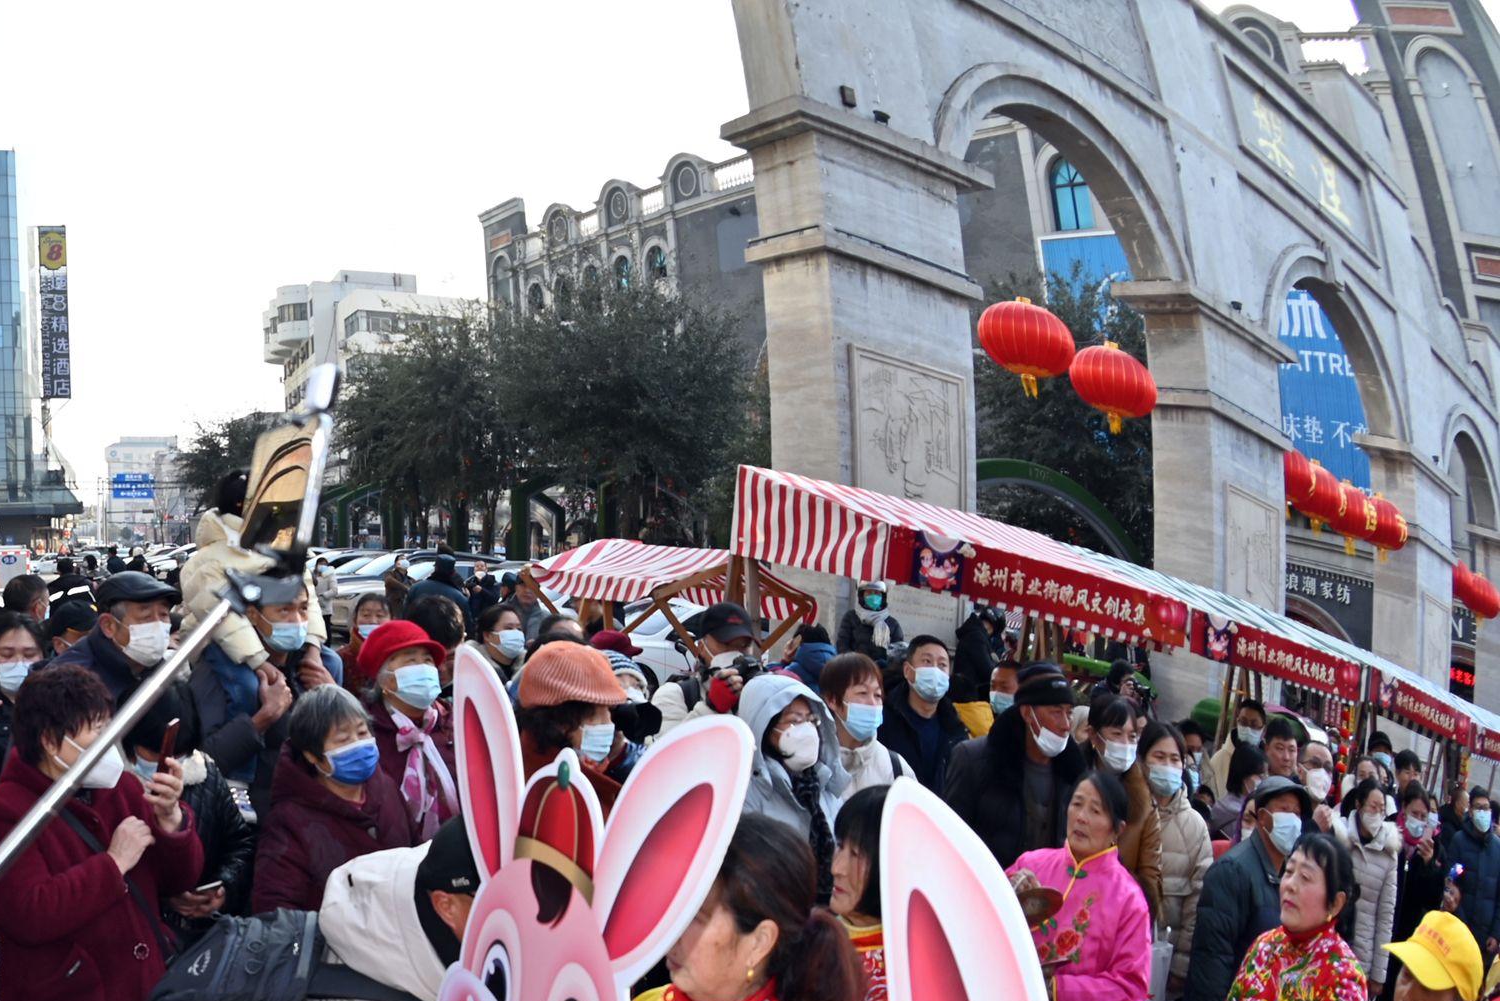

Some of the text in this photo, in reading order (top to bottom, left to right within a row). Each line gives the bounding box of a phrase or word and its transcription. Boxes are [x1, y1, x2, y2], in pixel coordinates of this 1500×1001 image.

[46, 244, 64, 262] 8
[52, 275, 70, 396] 速8精选酒店
[1283, 413, 1324, 444] 床垫
[1286, 572, 1351, 605] 浪潮家纺
